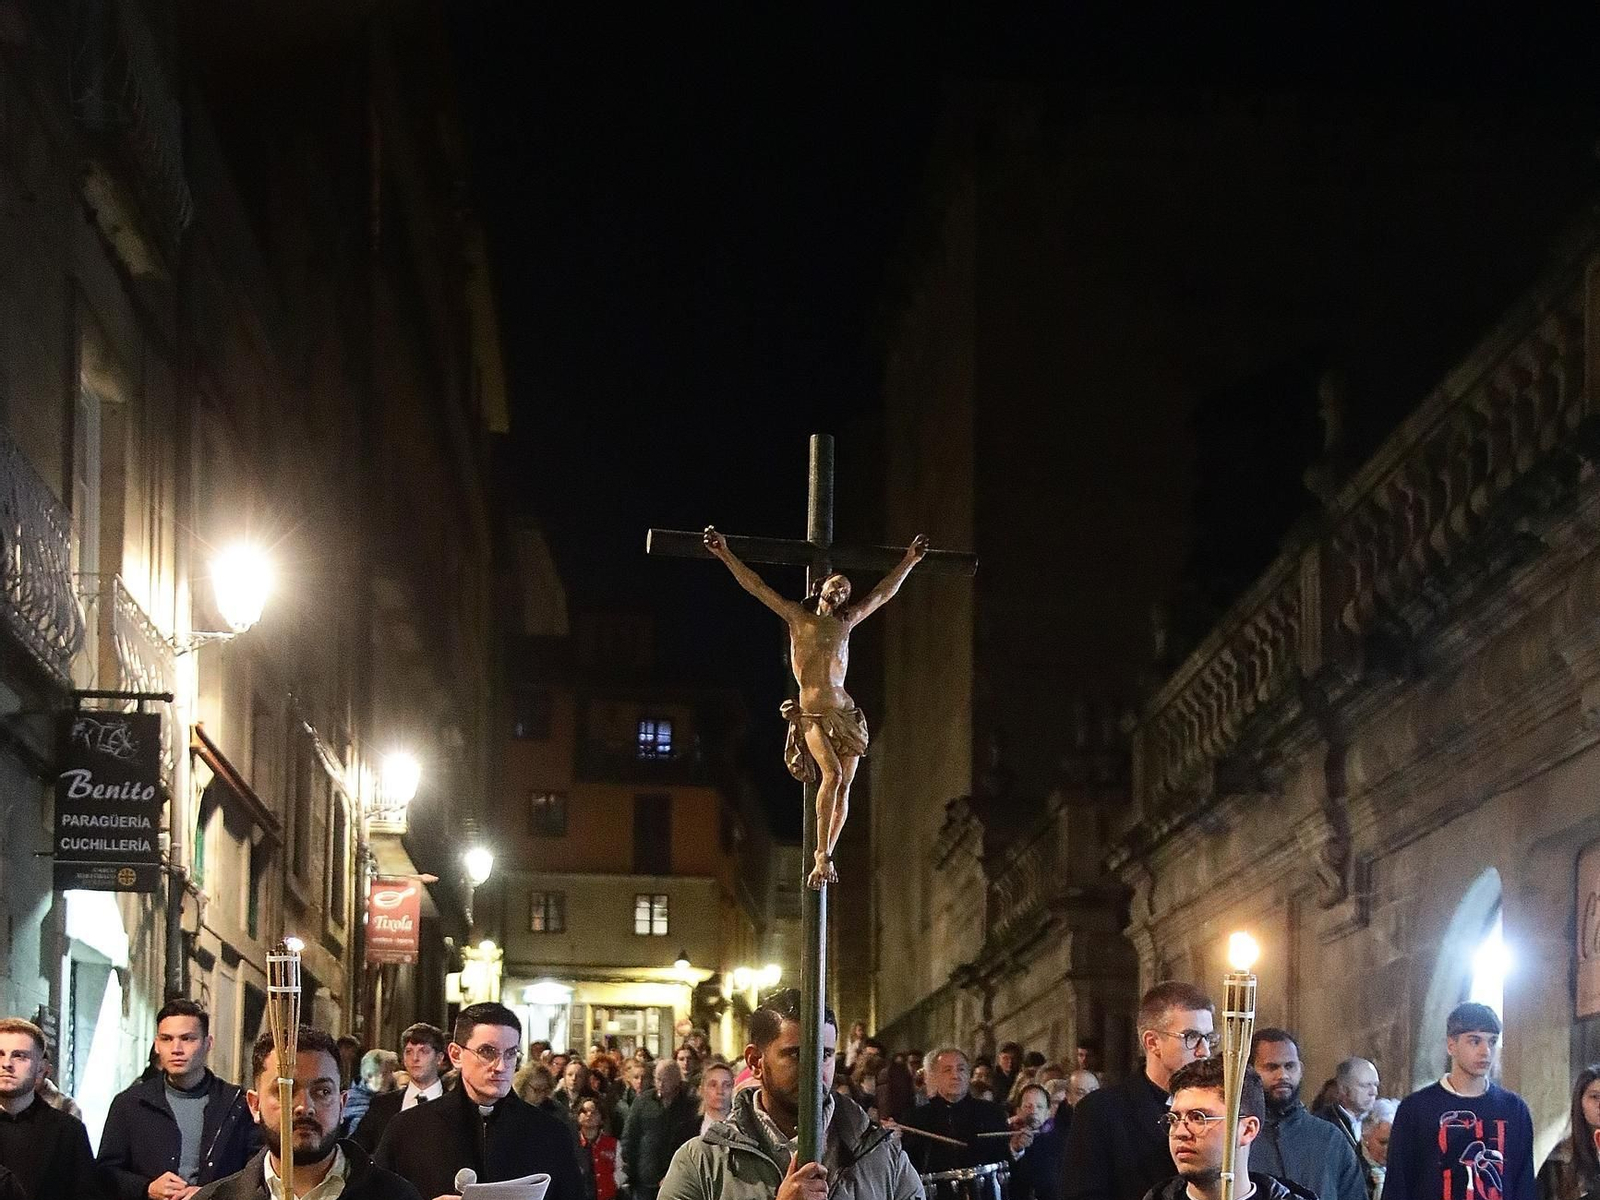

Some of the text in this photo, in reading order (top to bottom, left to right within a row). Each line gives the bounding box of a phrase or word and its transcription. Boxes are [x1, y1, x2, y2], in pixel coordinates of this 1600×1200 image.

[59, 768, 155, 800] Benito
[61, 813, 151, 829] PARAGÜERÍA
[60, 837, 151, 851] CUCHILLERÍA
